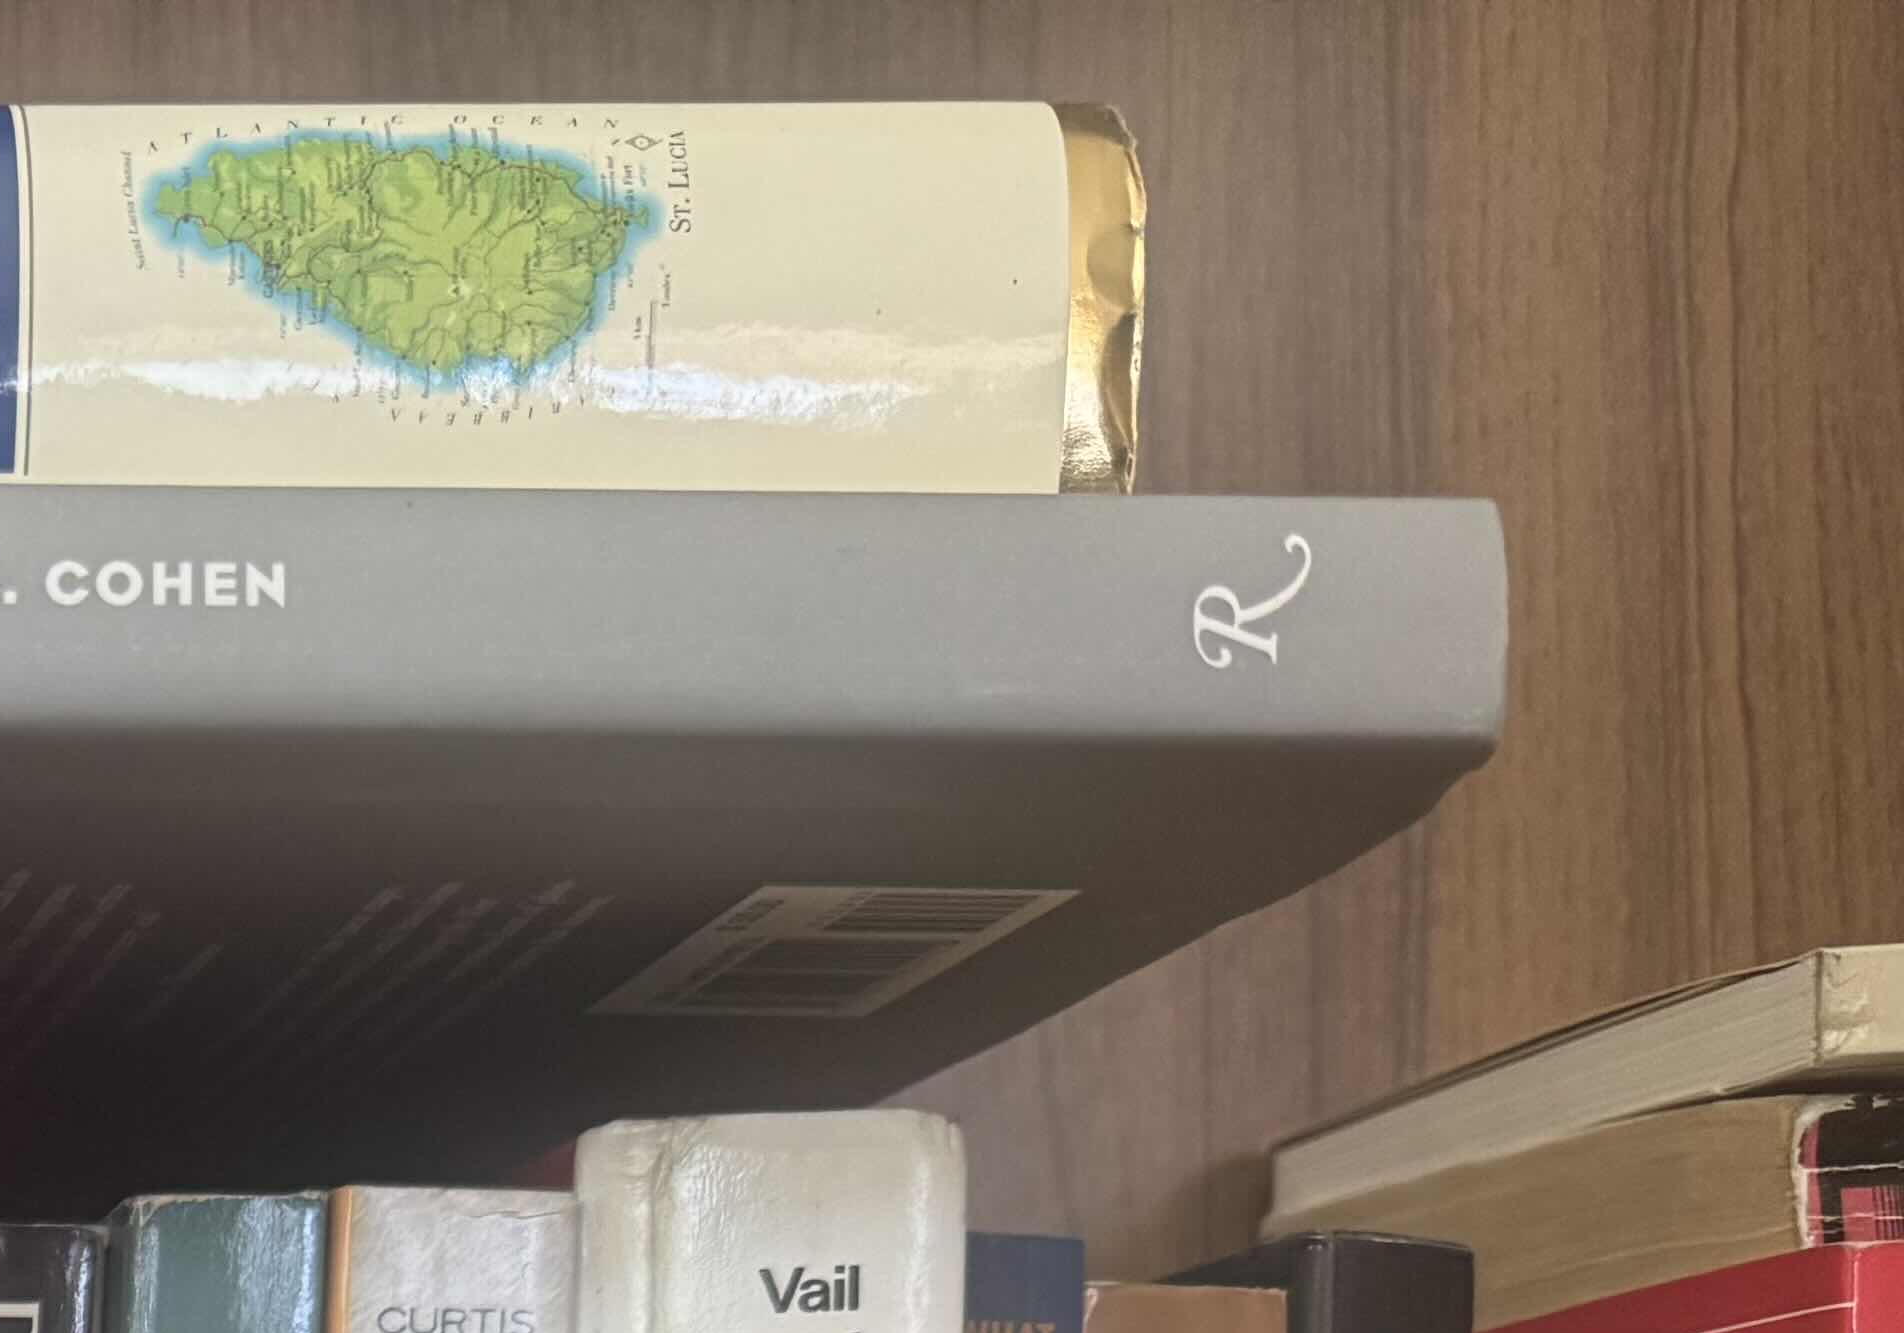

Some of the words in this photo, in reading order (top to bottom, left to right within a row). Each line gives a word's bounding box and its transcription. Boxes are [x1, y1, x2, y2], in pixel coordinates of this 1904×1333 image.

[667, 130, 691, 190] LUCIA
[668, 197, 693, 234] ST.
[45, 558, 287, 609] COHEN
[759, 1264, 861, 1315] Vail
